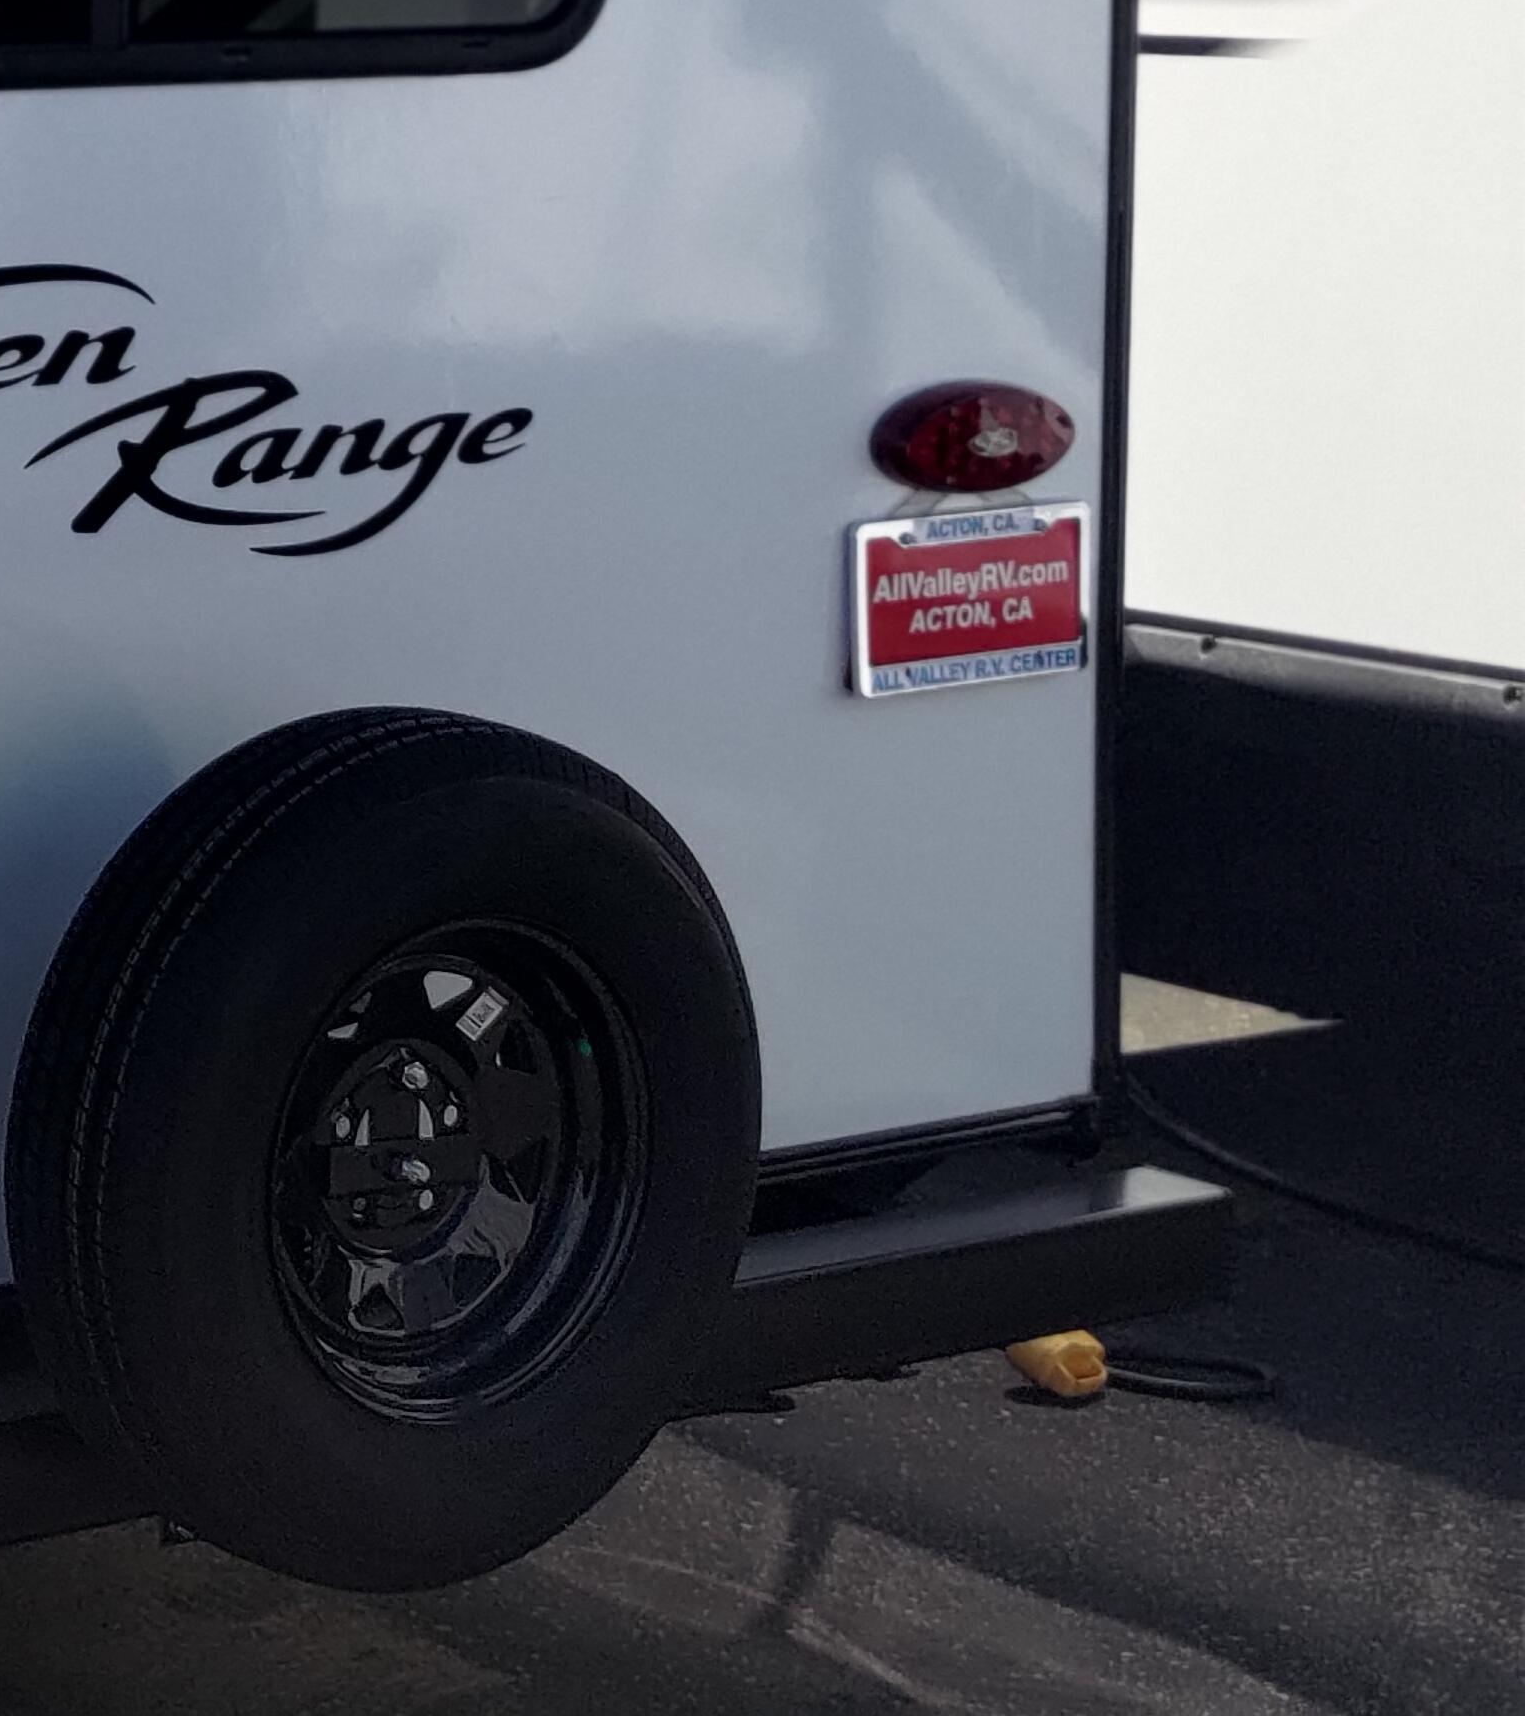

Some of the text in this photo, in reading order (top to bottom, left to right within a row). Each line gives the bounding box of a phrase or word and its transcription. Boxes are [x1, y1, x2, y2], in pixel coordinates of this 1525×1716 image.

[23, 369, 534, 557] Range
[925, 514, 989, 540] ACTON,
[873, 560, 1069, 603] AllValleyRV.com
[909, 596, 1033, 634] ACTON, CA
[905, 661, 971, 687] VALLEY
[1010, 648, 1076, 673] CENTER
